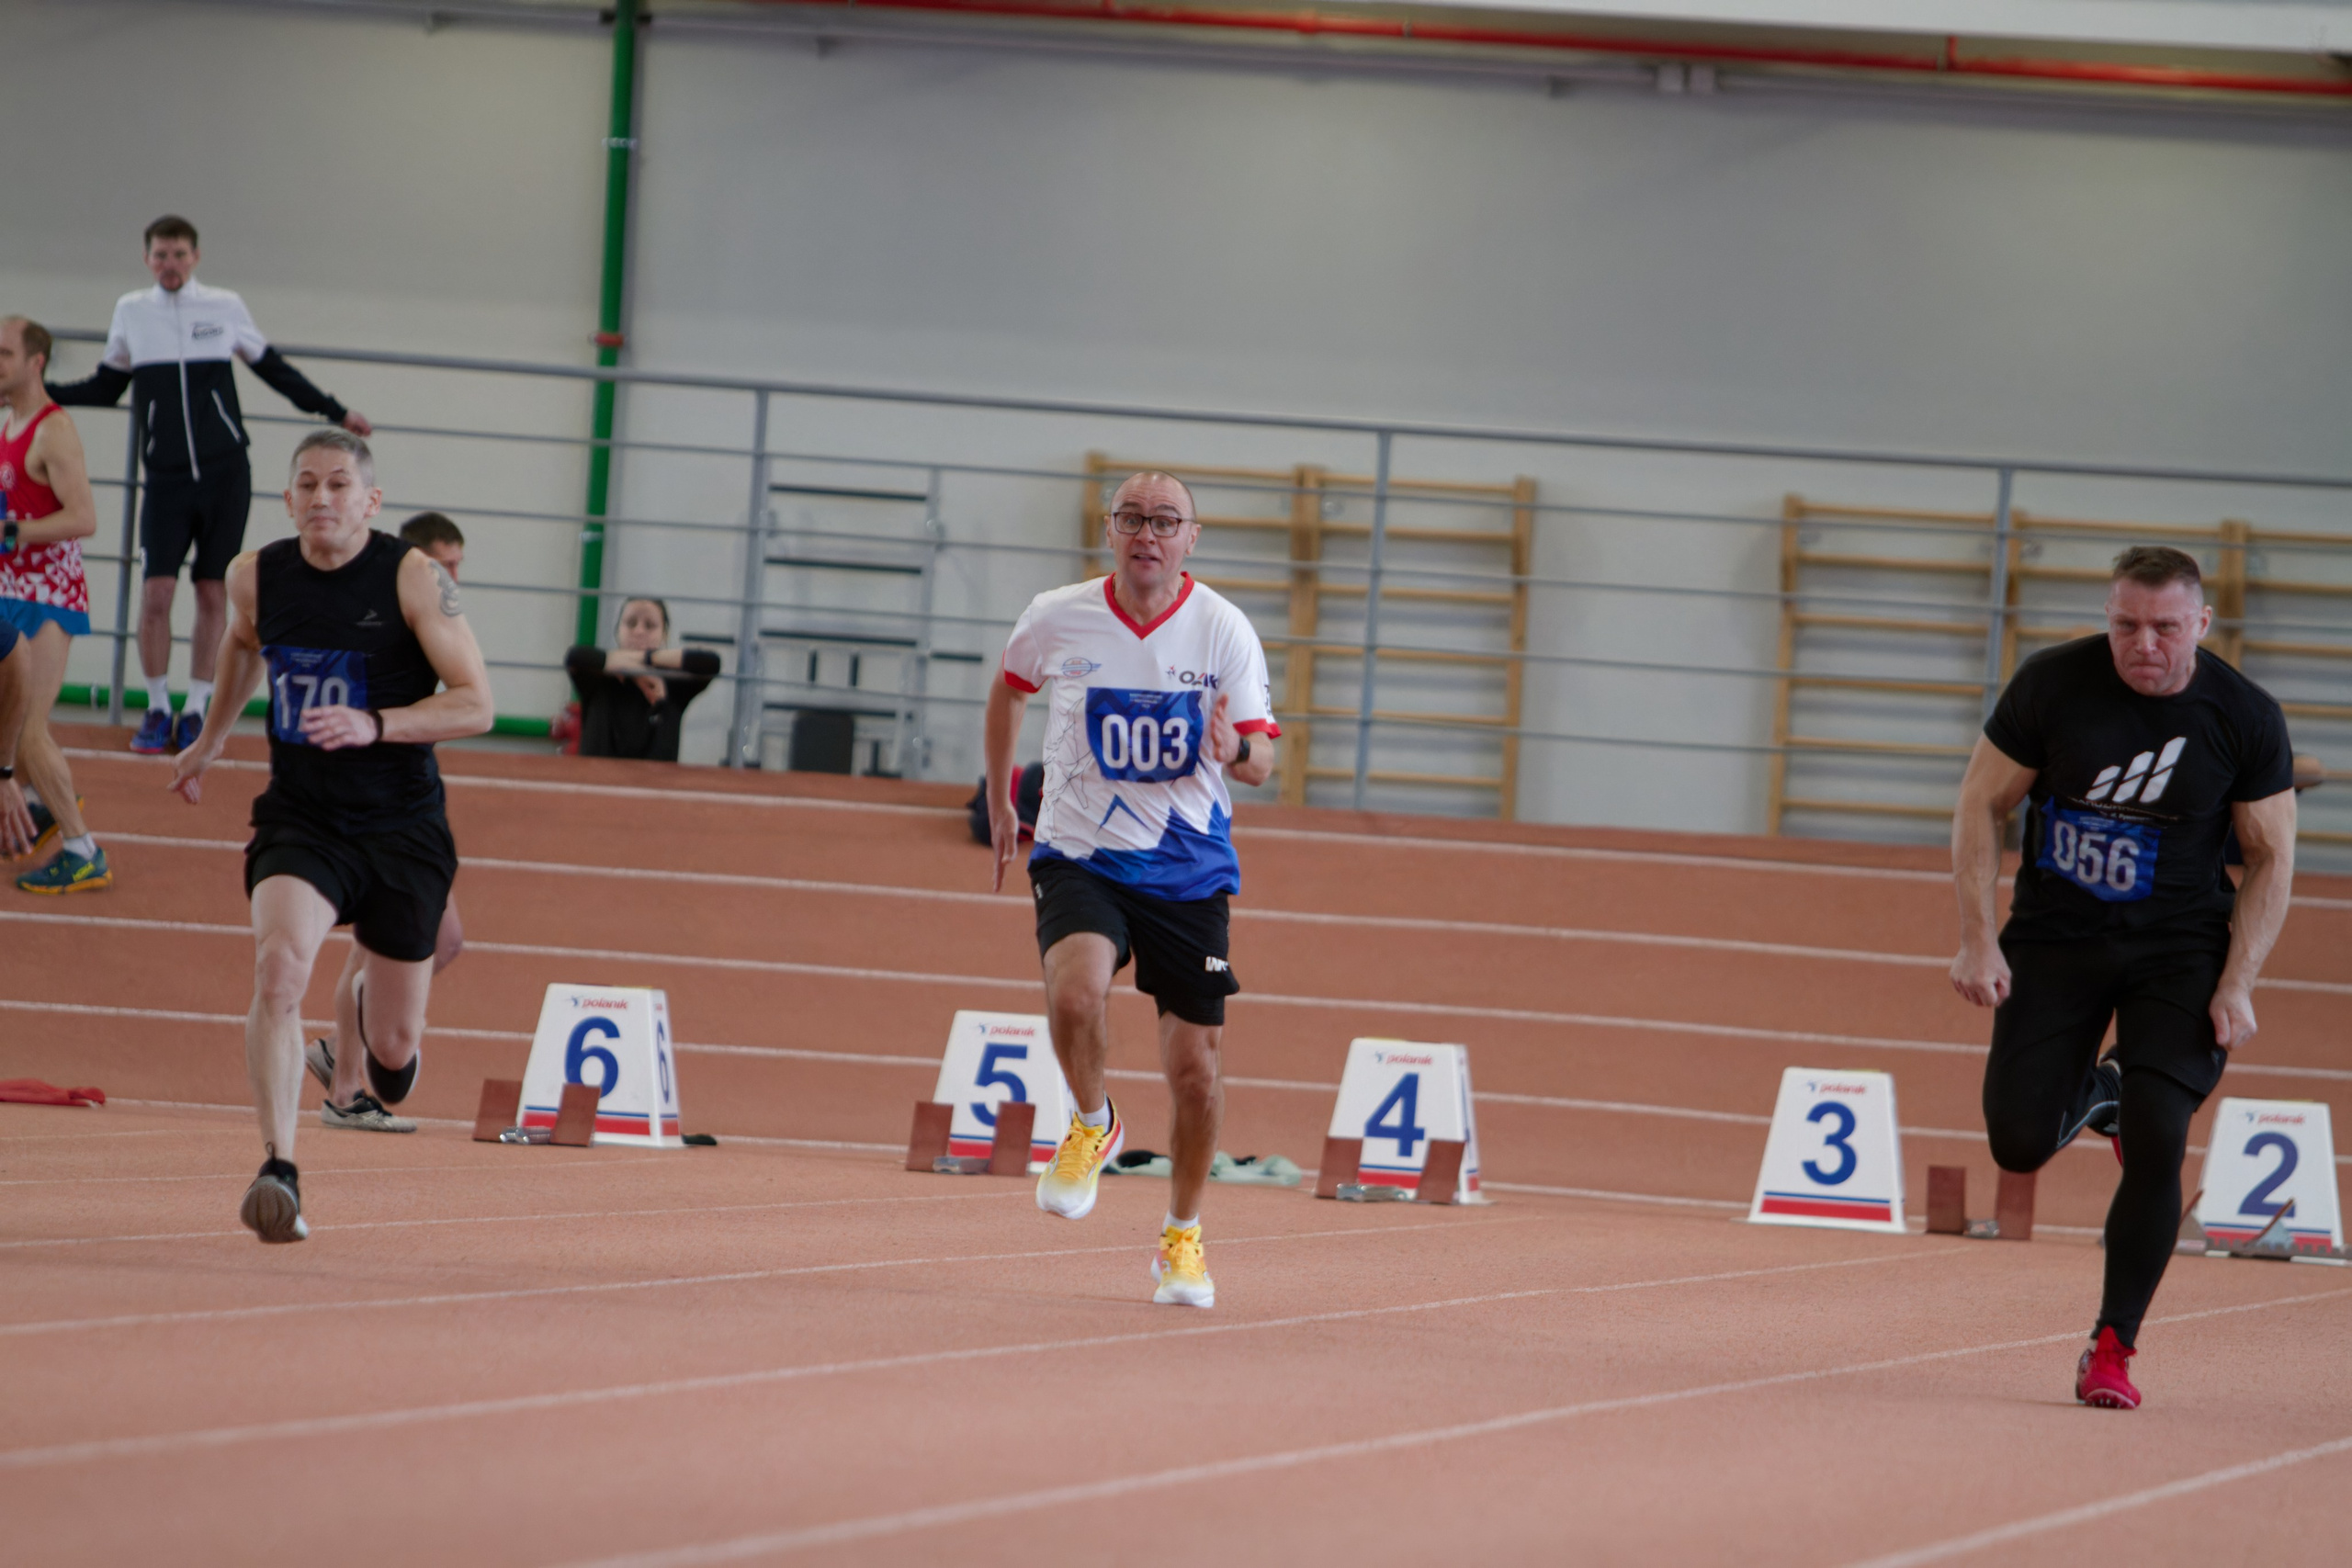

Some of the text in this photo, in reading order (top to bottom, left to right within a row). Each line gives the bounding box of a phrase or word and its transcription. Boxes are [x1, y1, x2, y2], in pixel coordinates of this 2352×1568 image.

[1102, 713, 1189, 772] 003
[2052, 819, 2140, 892] 056
[582, 997, 629, 1010] polanik
[989, 1024, 1035, 1037] polanik
[564, 1015, 621, 1100] 6
[970, 1042, 1028, 1127] 5
[1363, 1071, 1425, 1158] 4
[1802, 1100, 1857, 1186] 3
[2237, 1130, 2299, 1219] 2
